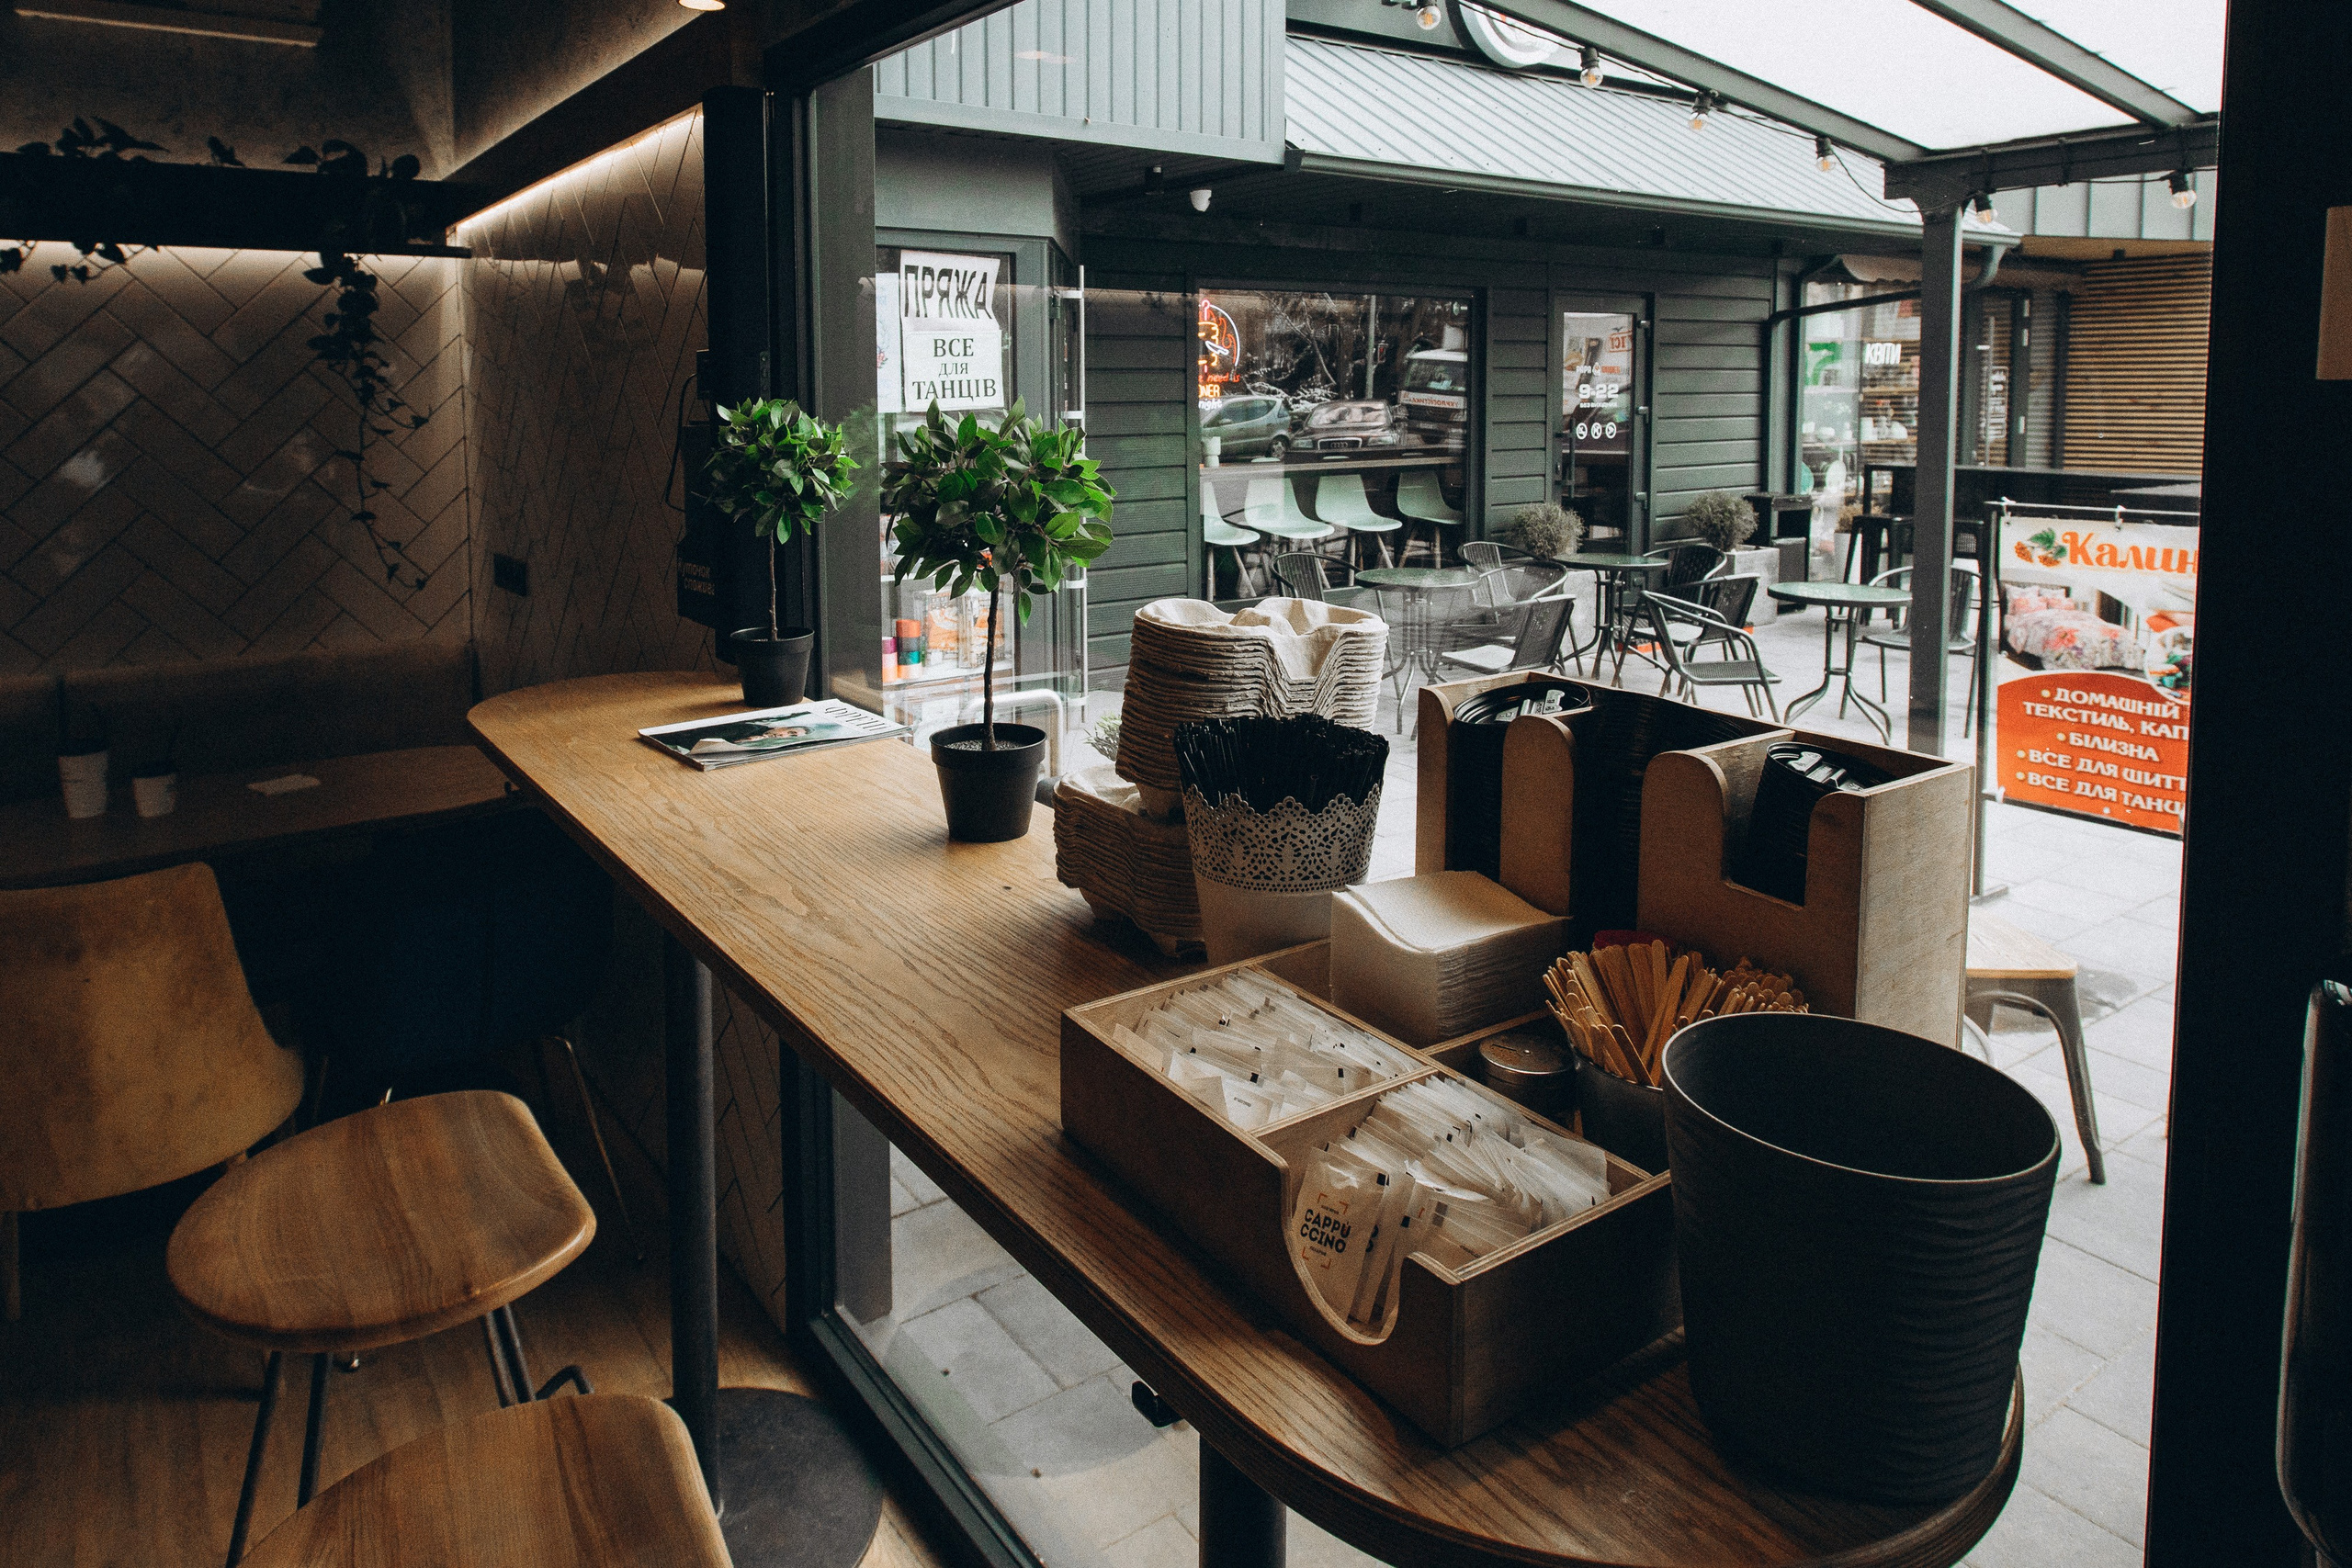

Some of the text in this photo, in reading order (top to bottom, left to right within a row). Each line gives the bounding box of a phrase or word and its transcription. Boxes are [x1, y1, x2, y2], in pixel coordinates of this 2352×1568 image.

[904, 265, 993, 320] ПРЯЖА
[933, 338, 974, 357] ВСЕ
[912, 378, 997, 402] ТАНЦІВ
[2022, 701, 2135, 734] ТЕКСТИЛЬ,
[2053, 687, 2180, 720] ДОМАШНІЙ
[2069, 731, 2161, 762] БІЛИЗНА
[2029, 749, 2072, 769] ВСЕ
[2075, 757, 2119, 779] ДЛЯ
[2027, 772, 2070, 793] ВСЕ
[2074, 781, 2117, 802] ДЛЯ
[1300, 1223, 1347, 1253] CCINO
